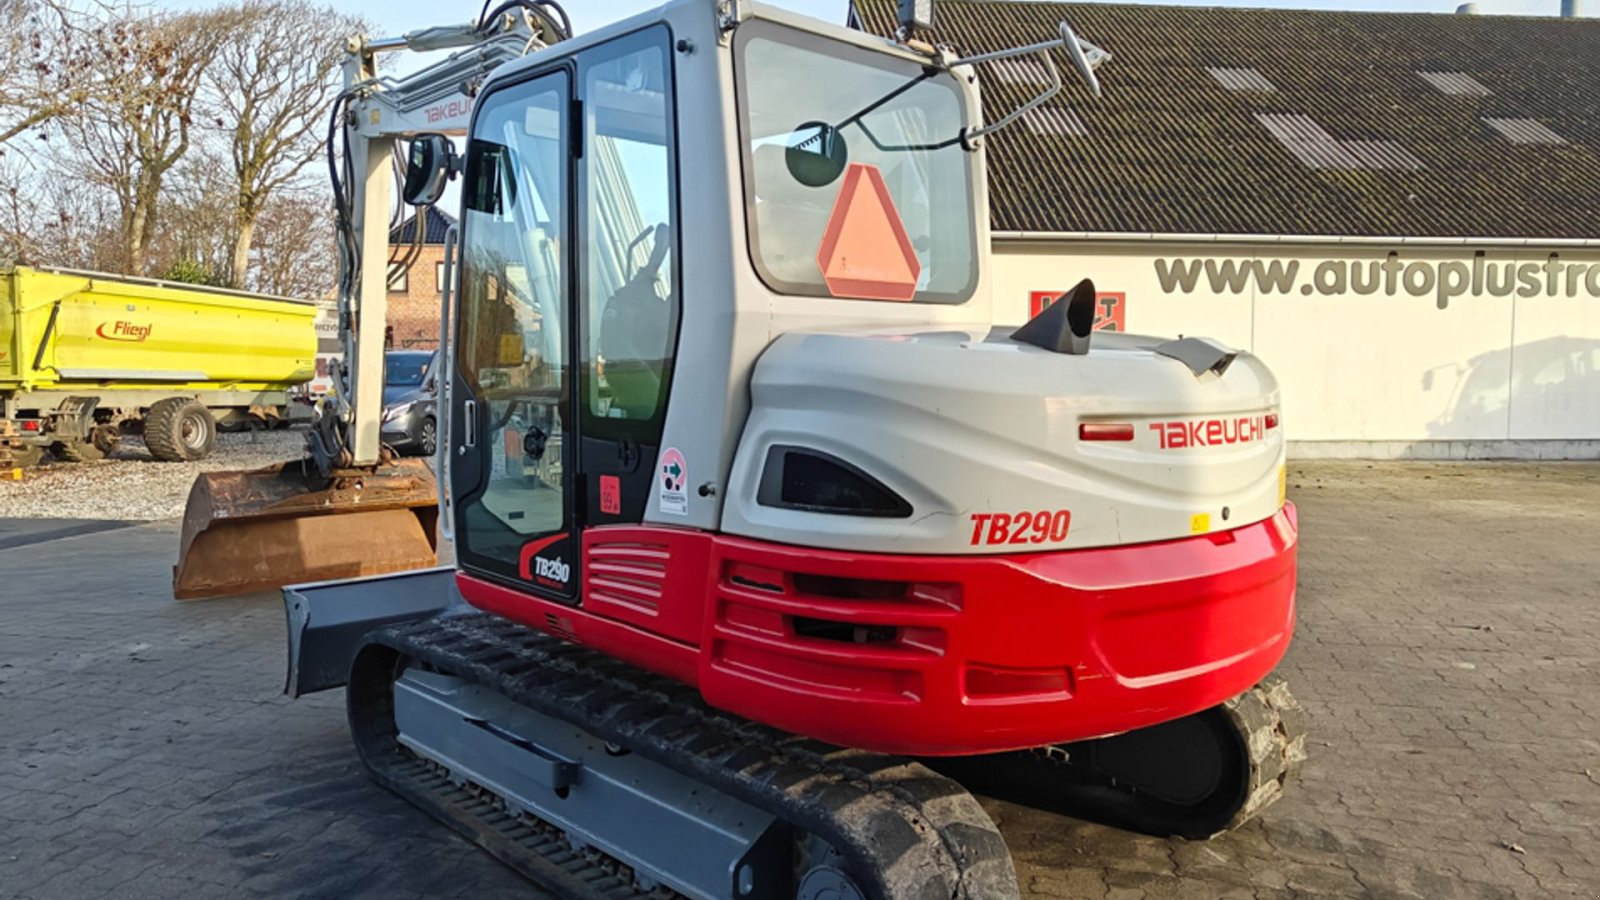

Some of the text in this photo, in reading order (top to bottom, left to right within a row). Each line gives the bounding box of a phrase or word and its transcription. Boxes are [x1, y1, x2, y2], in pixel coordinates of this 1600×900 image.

[113, 320, 153, 342] Fliegl
[1148, 416, 1264, 450] TAKEUCHI
[969, 509, 1072, 546] TB290
[535, 556, 570, 583] TB290
